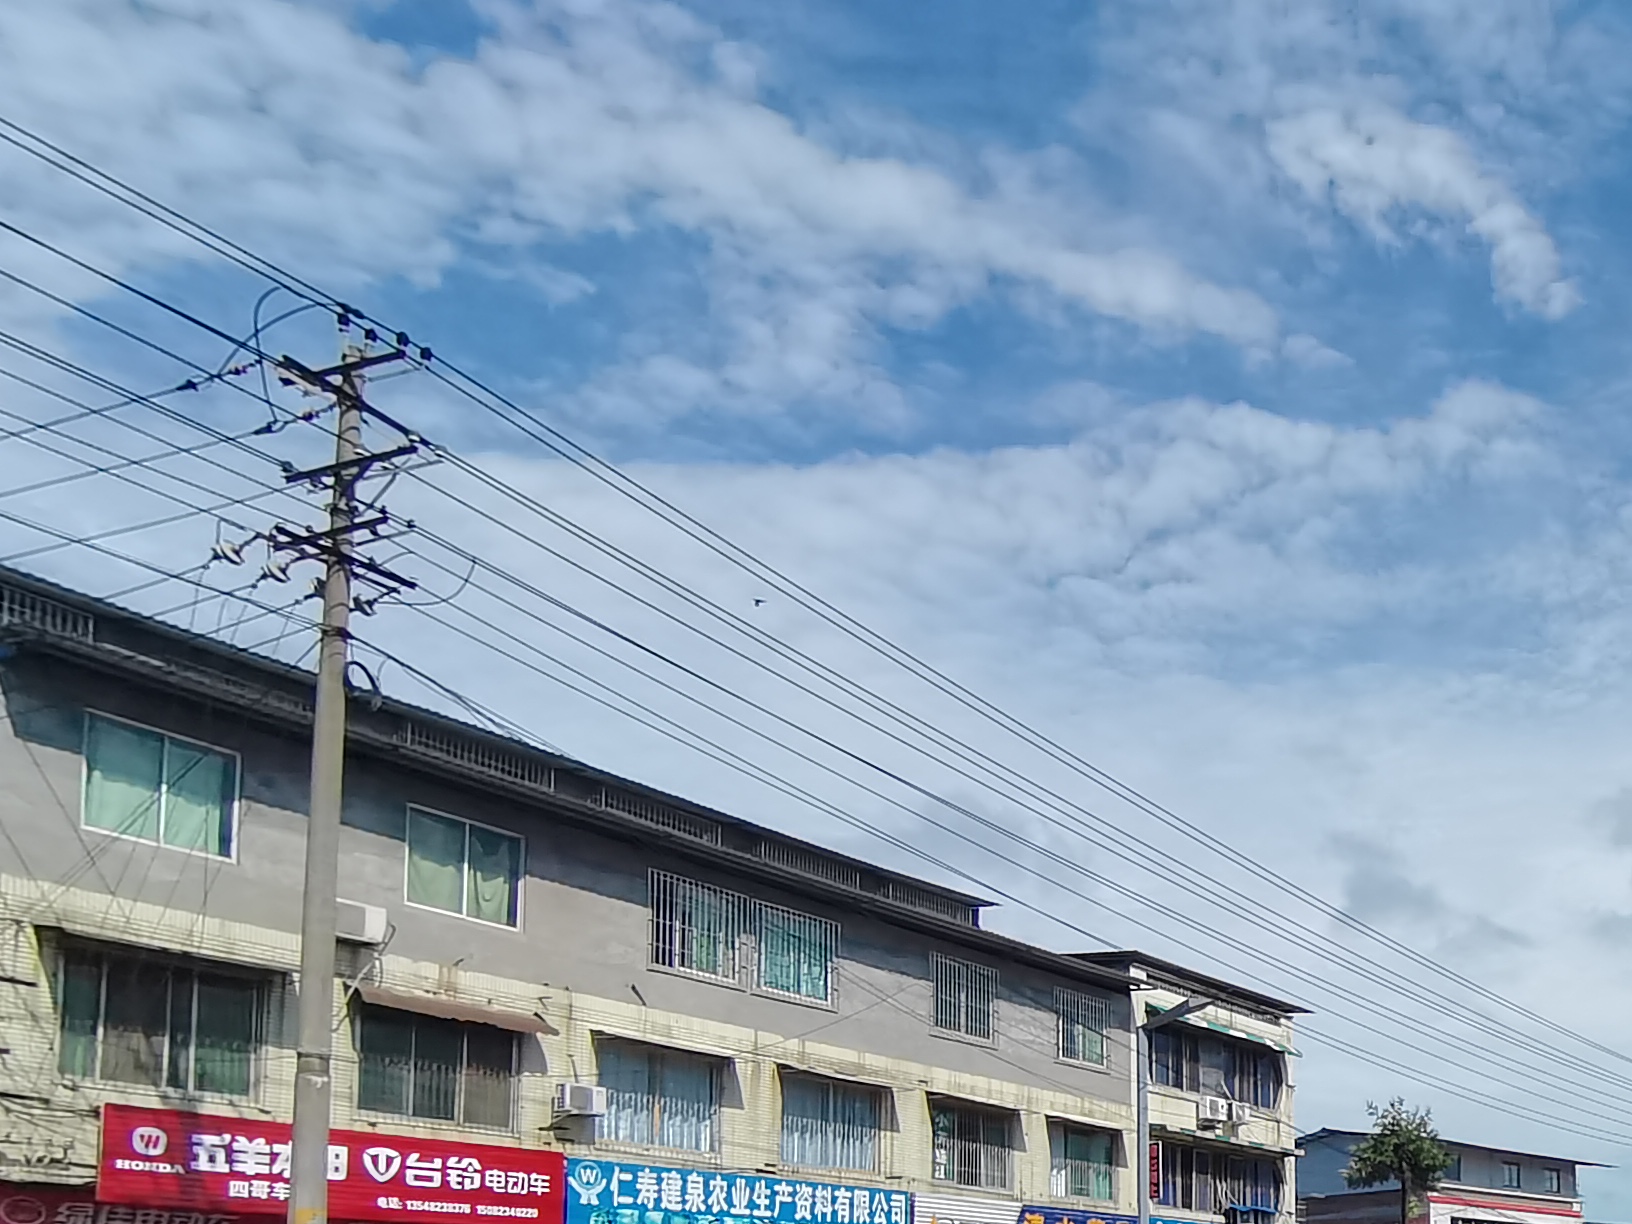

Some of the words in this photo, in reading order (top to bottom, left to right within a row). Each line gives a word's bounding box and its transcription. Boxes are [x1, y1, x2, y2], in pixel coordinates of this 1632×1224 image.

[115, 1159, 186, 1175] HONDA
[405, 1152, 551, 1196] 台铃电动车
